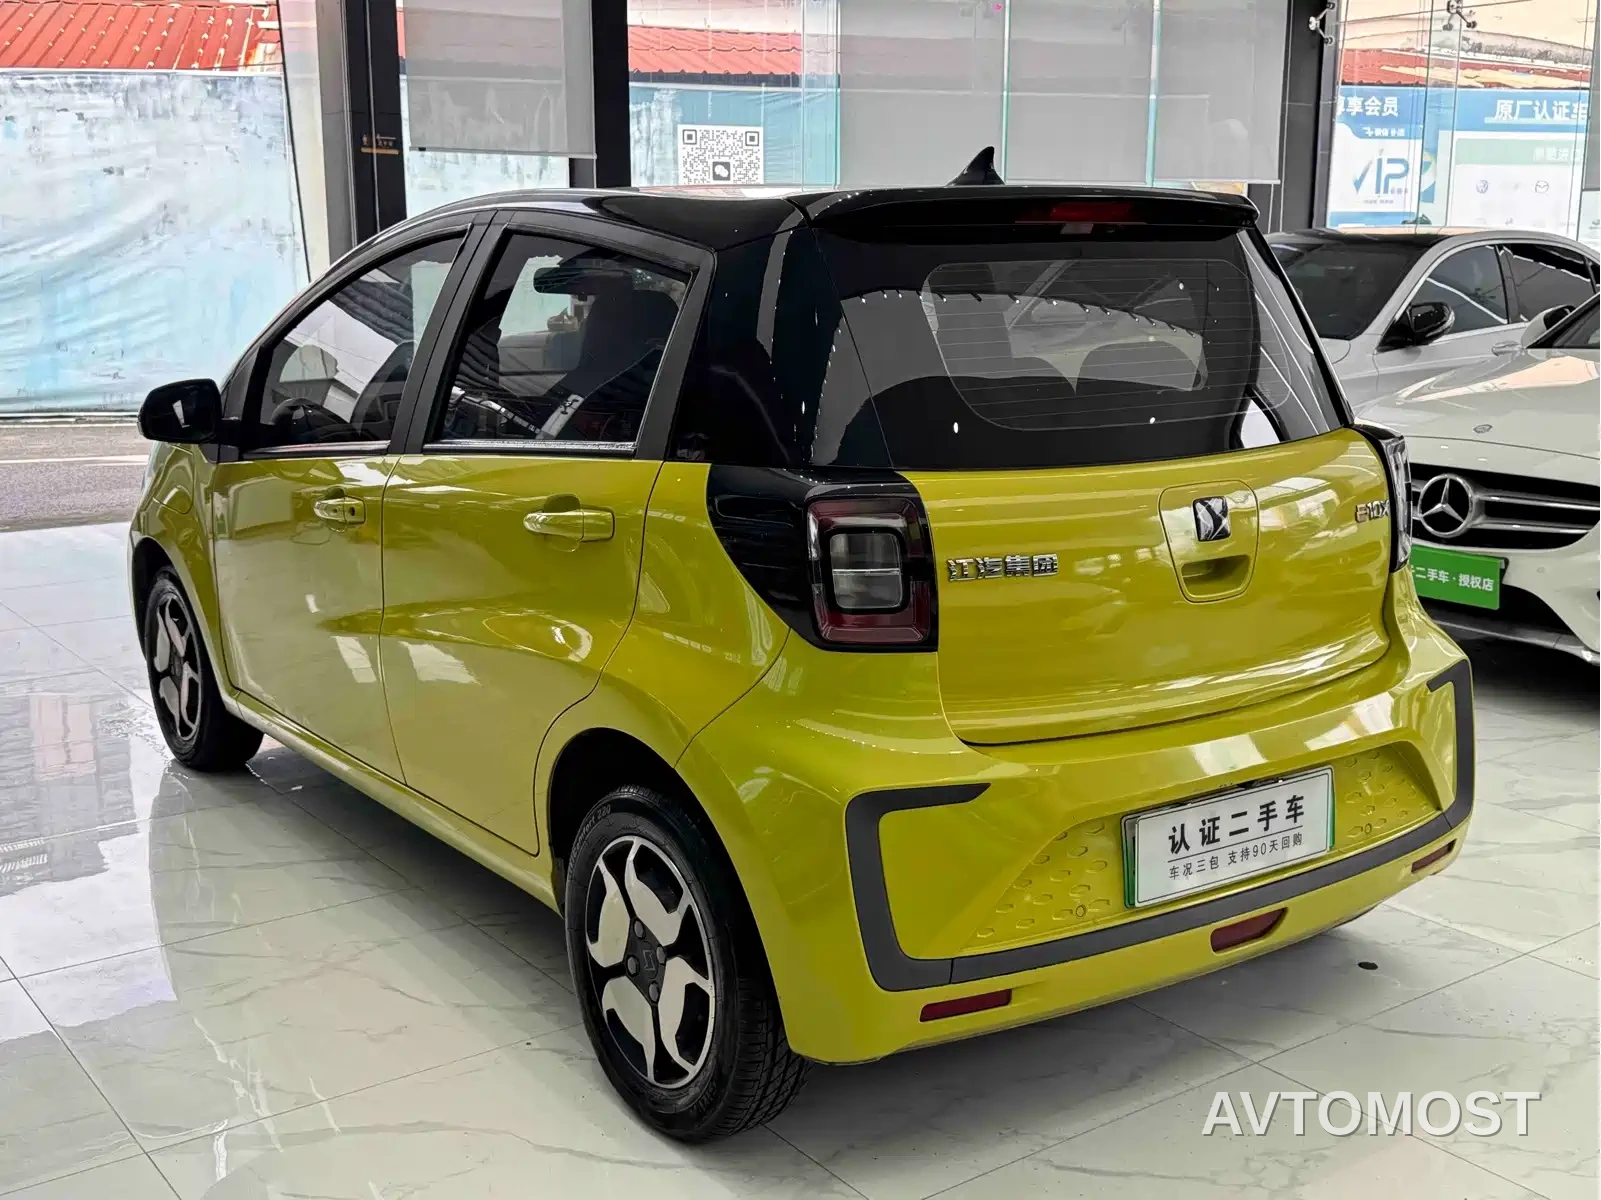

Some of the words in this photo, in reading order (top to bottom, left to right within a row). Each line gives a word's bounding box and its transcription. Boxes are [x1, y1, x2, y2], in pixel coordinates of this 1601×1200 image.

[1494, 99, 1588, 121] 原厂认证车
[947, 554, 1058, 581] 江汽集团
[1168, 795, 1304, 854] 认证二手车
[1169, 855, 1219, 880] 车况三包
[1228, 832, 1303, 866] 支持90天回购
